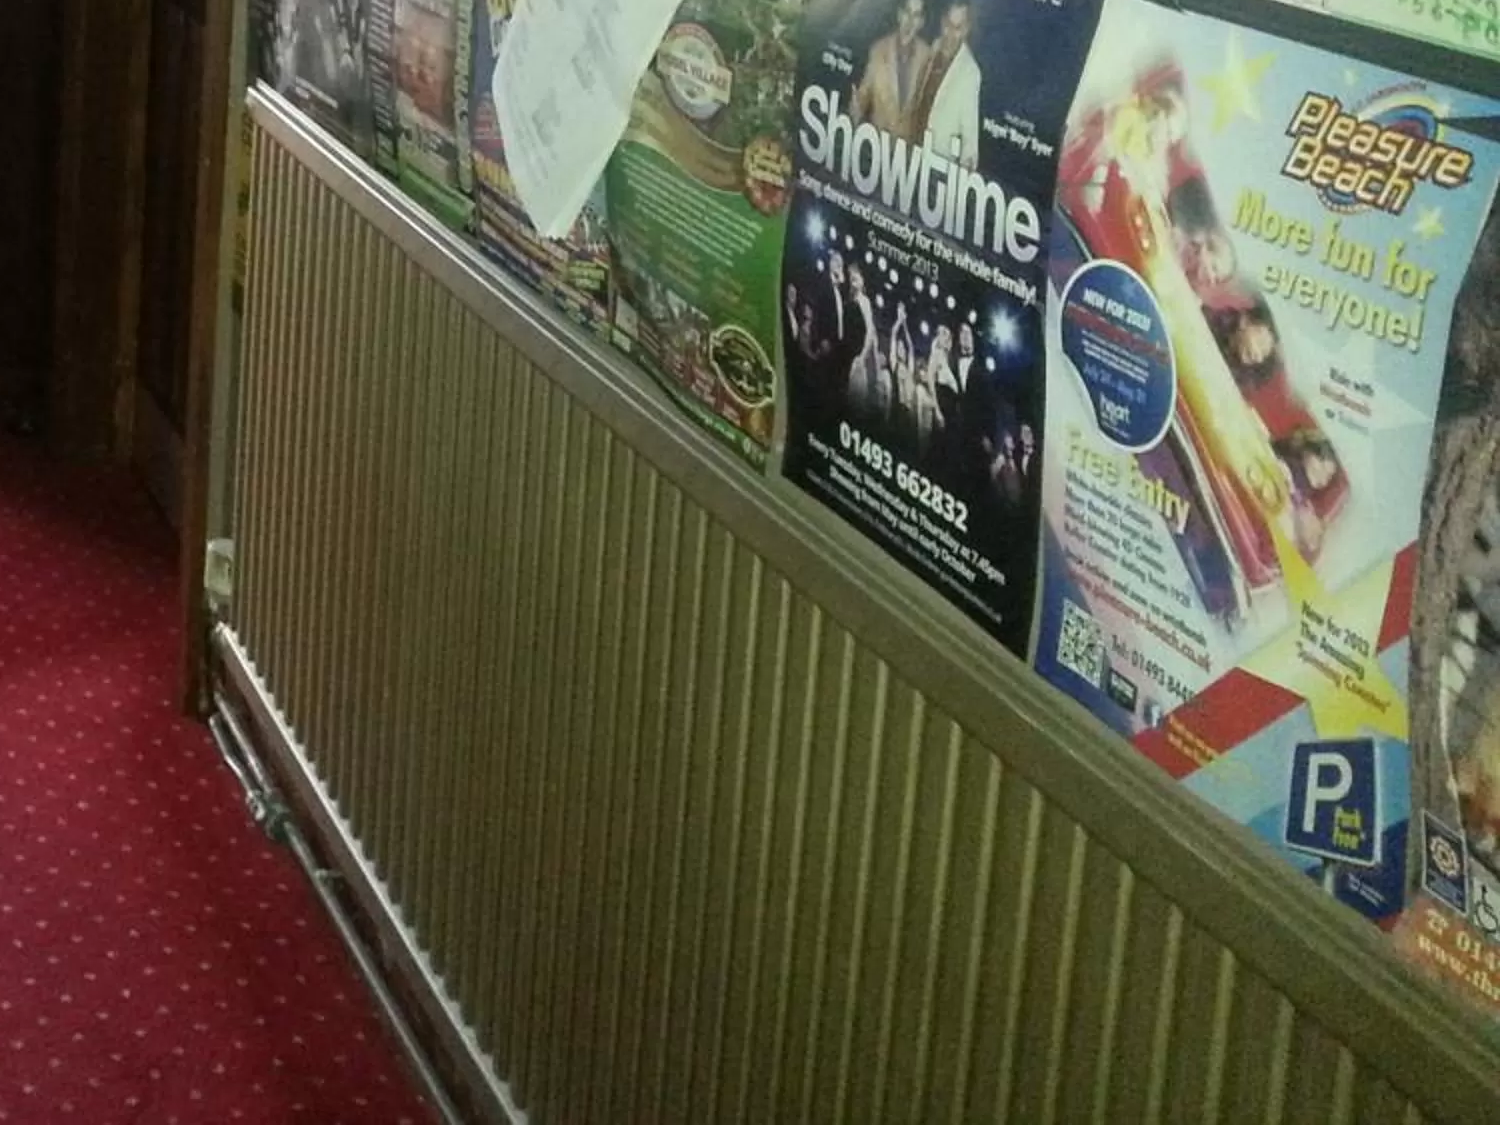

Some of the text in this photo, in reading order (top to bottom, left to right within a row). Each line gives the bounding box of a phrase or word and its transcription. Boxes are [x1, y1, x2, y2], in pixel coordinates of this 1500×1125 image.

[799, 84, 1041, 263] Showtime
[1281, 132, 1415, 214] Beach
[1286, 91, 1474, 187] Pleasure
[849, 195, 872, 223] and
[871, 208, 916, 246] comedy
[915, 224, 935, 252] for
[933, 233, 953, 264] the
[953, 245, 992, 285] whole
[867, 229, 941, 284] Summer 2013
[1232, 187, 1440, 304] More fun for
[1262, 262, 1426, 354] everyone!
[839, 420, 969, 534] 01493 662832
[1303, 752, 1354, 834] P
